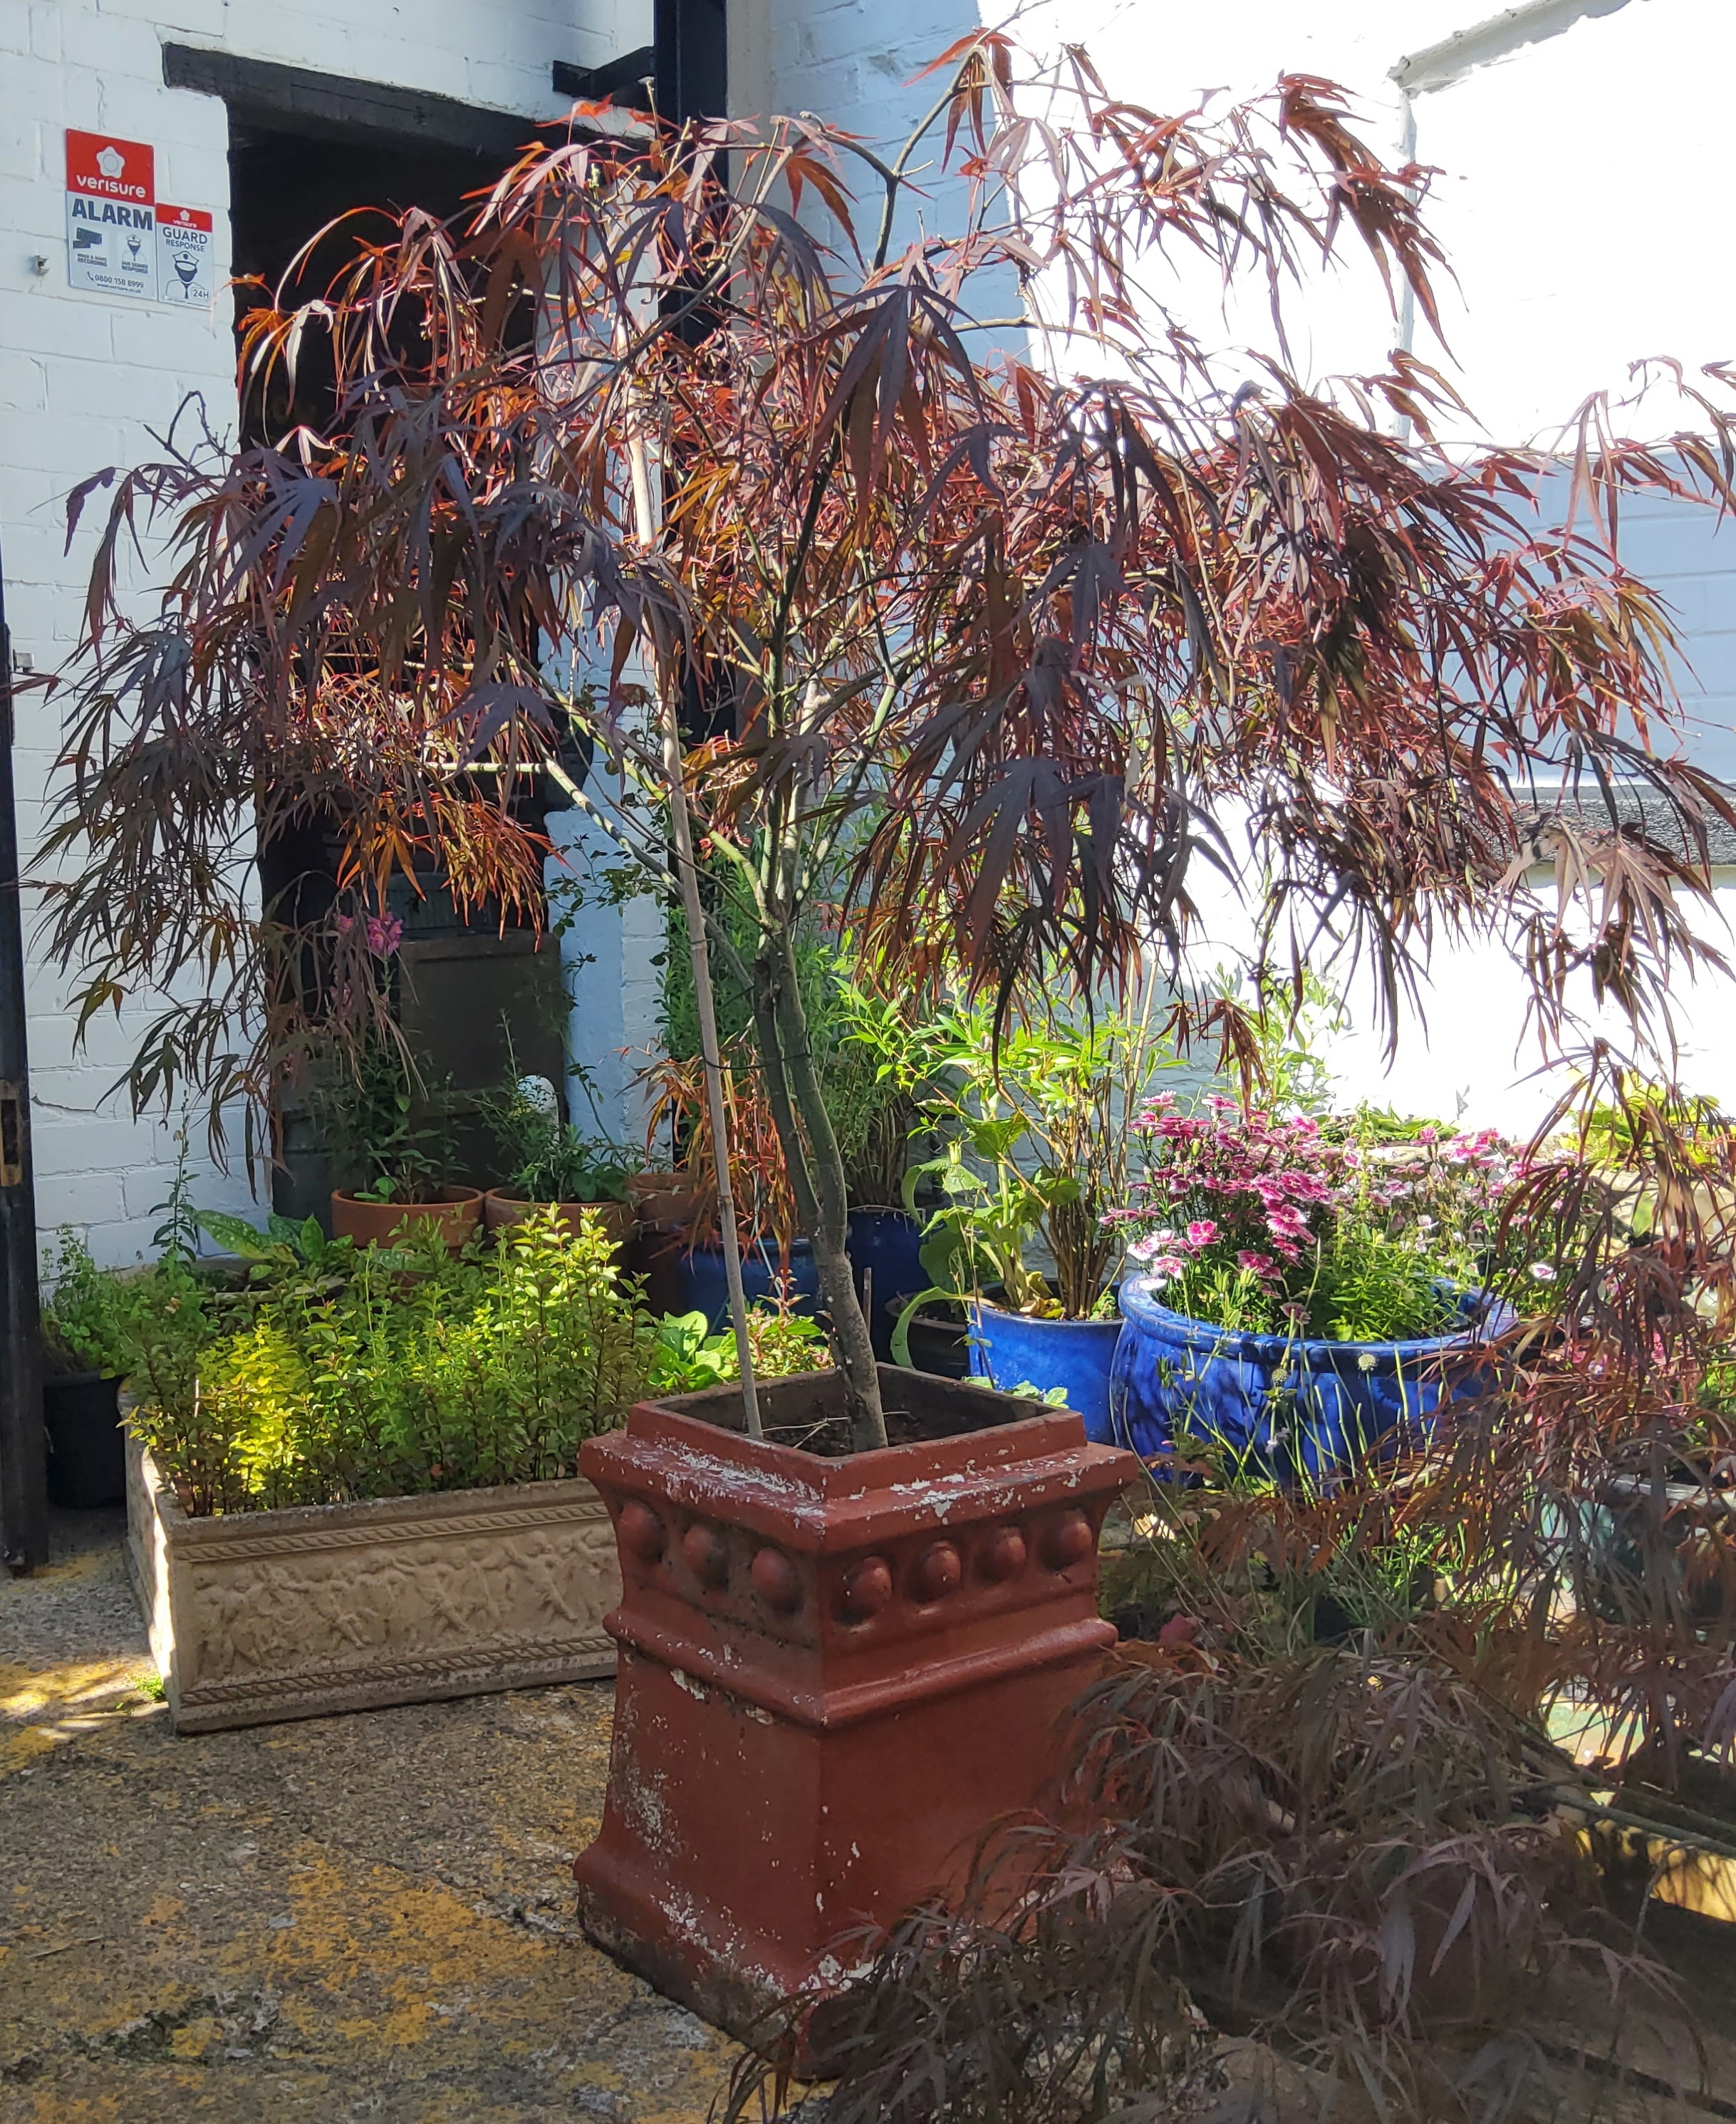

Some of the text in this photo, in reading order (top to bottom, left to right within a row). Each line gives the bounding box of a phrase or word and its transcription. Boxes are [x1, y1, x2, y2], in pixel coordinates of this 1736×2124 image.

[76, 175, 146, 198] verisure
[72, 198, 152, 231] ALARM
[162, 227, 207, 244] GUARD
[166, 239, 205, 252] RESPONSE
[95, 274, 113, 283] 0800
[128, 280, 144, 289] 8999
[193, 289, 209, 299] 24H
